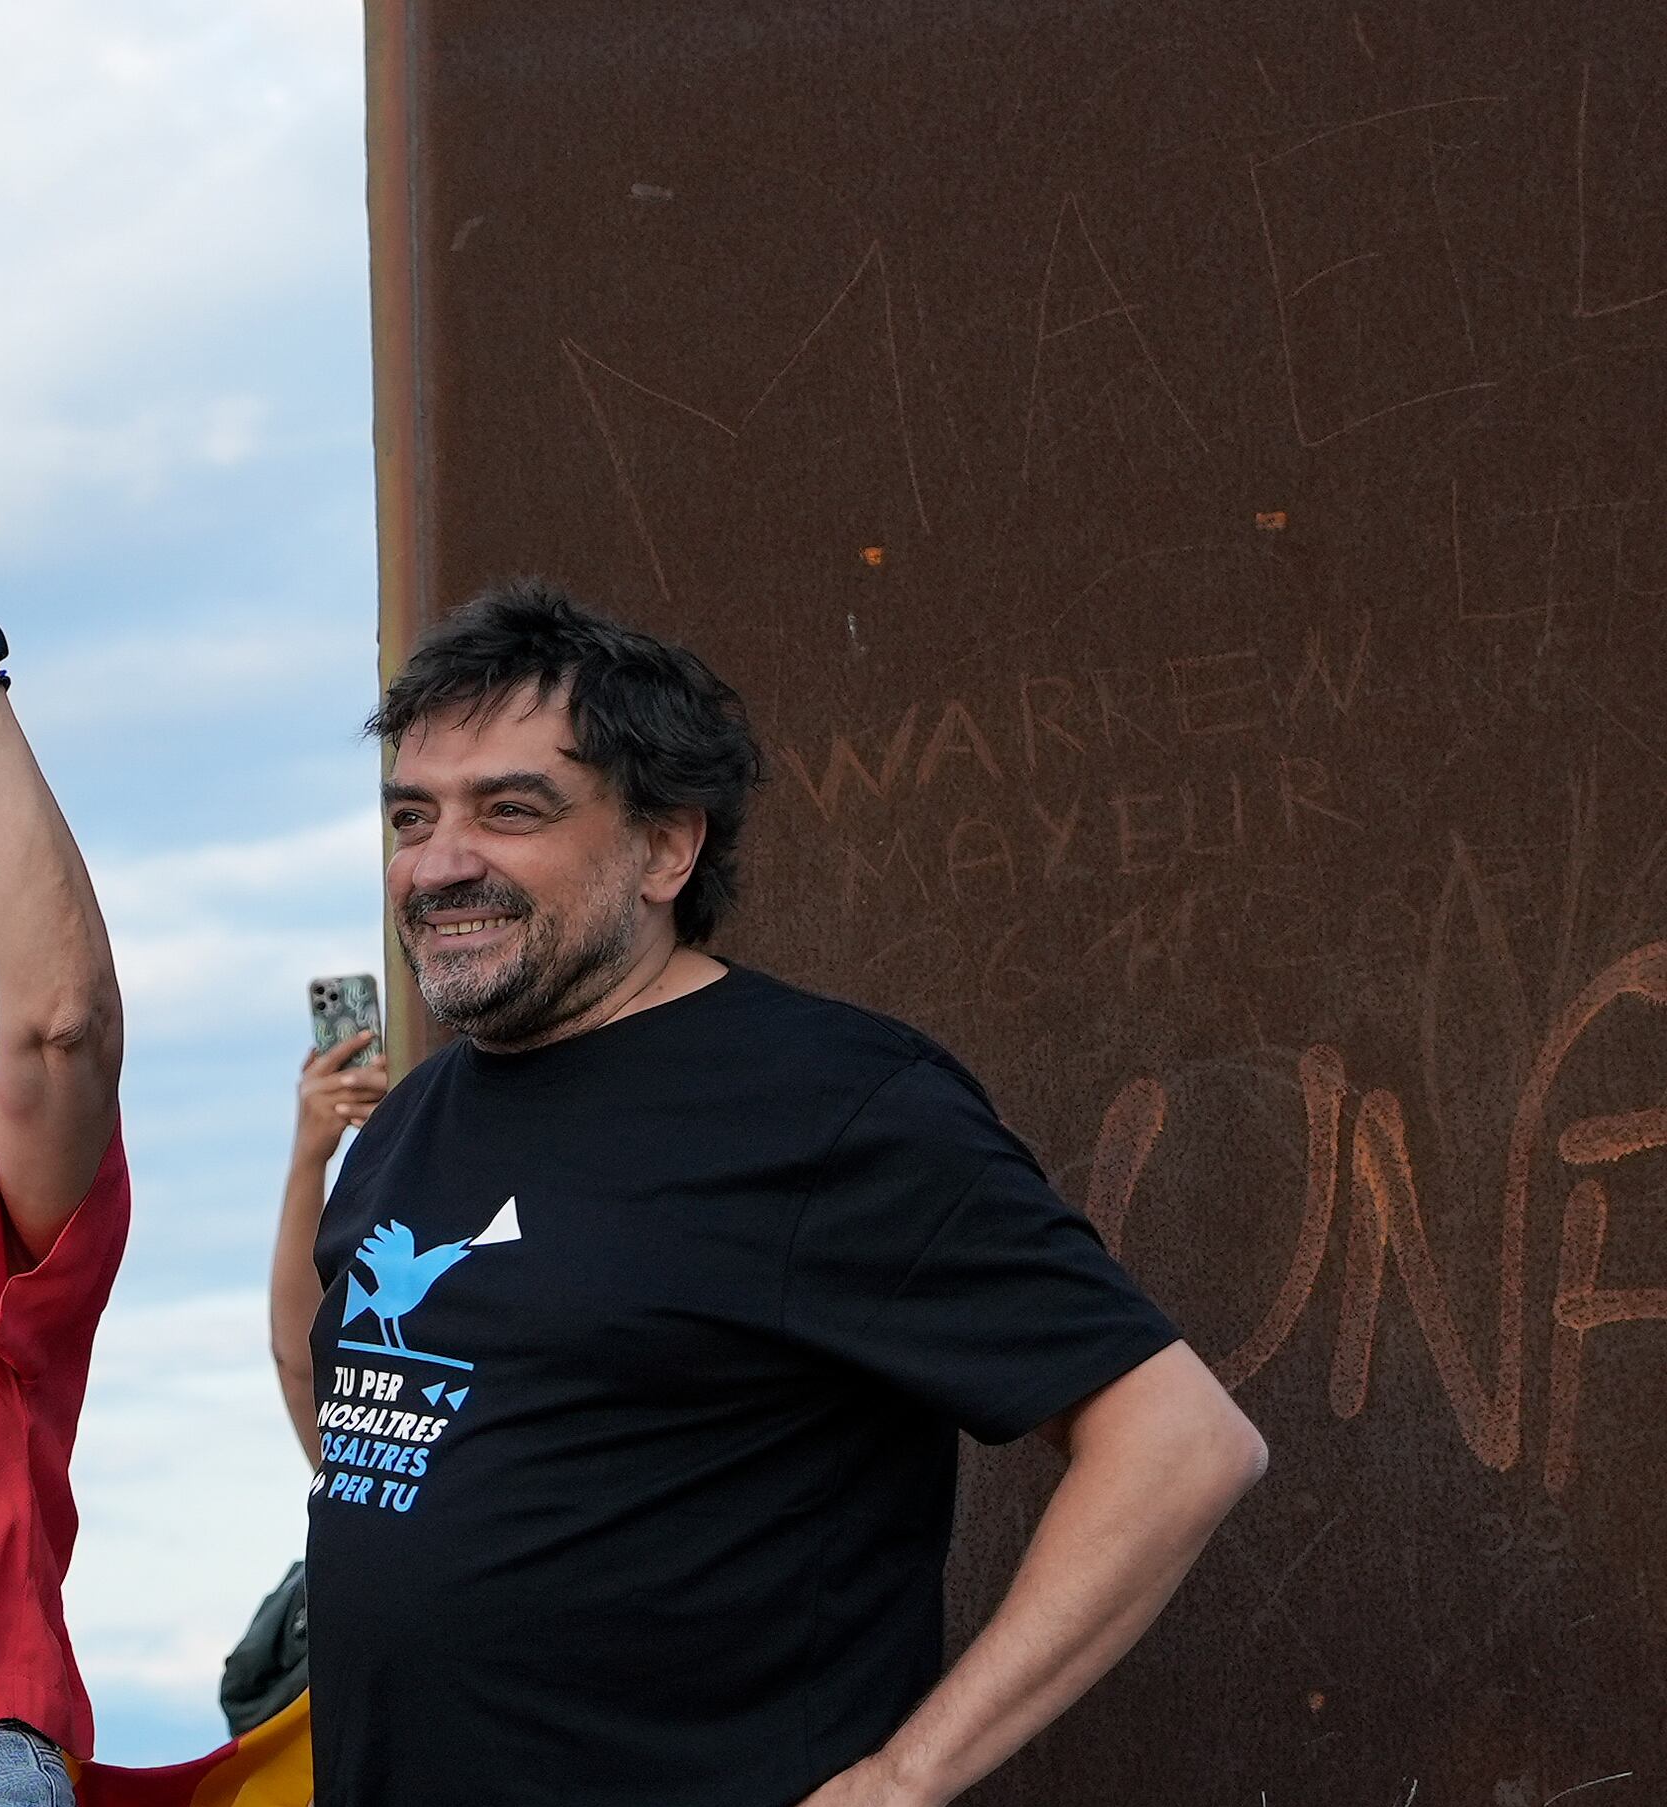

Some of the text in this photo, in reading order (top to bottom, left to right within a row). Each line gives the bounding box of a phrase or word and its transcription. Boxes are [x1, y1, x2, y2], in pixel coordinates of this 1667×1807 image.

[332, 1366, 404, 1401] TU PER
[317, 1401, 449, 1443] NOSALTRES
[320, 1431, 430, 1478] OSALTRES
[327, 1471, 419, 1513] PER TU
